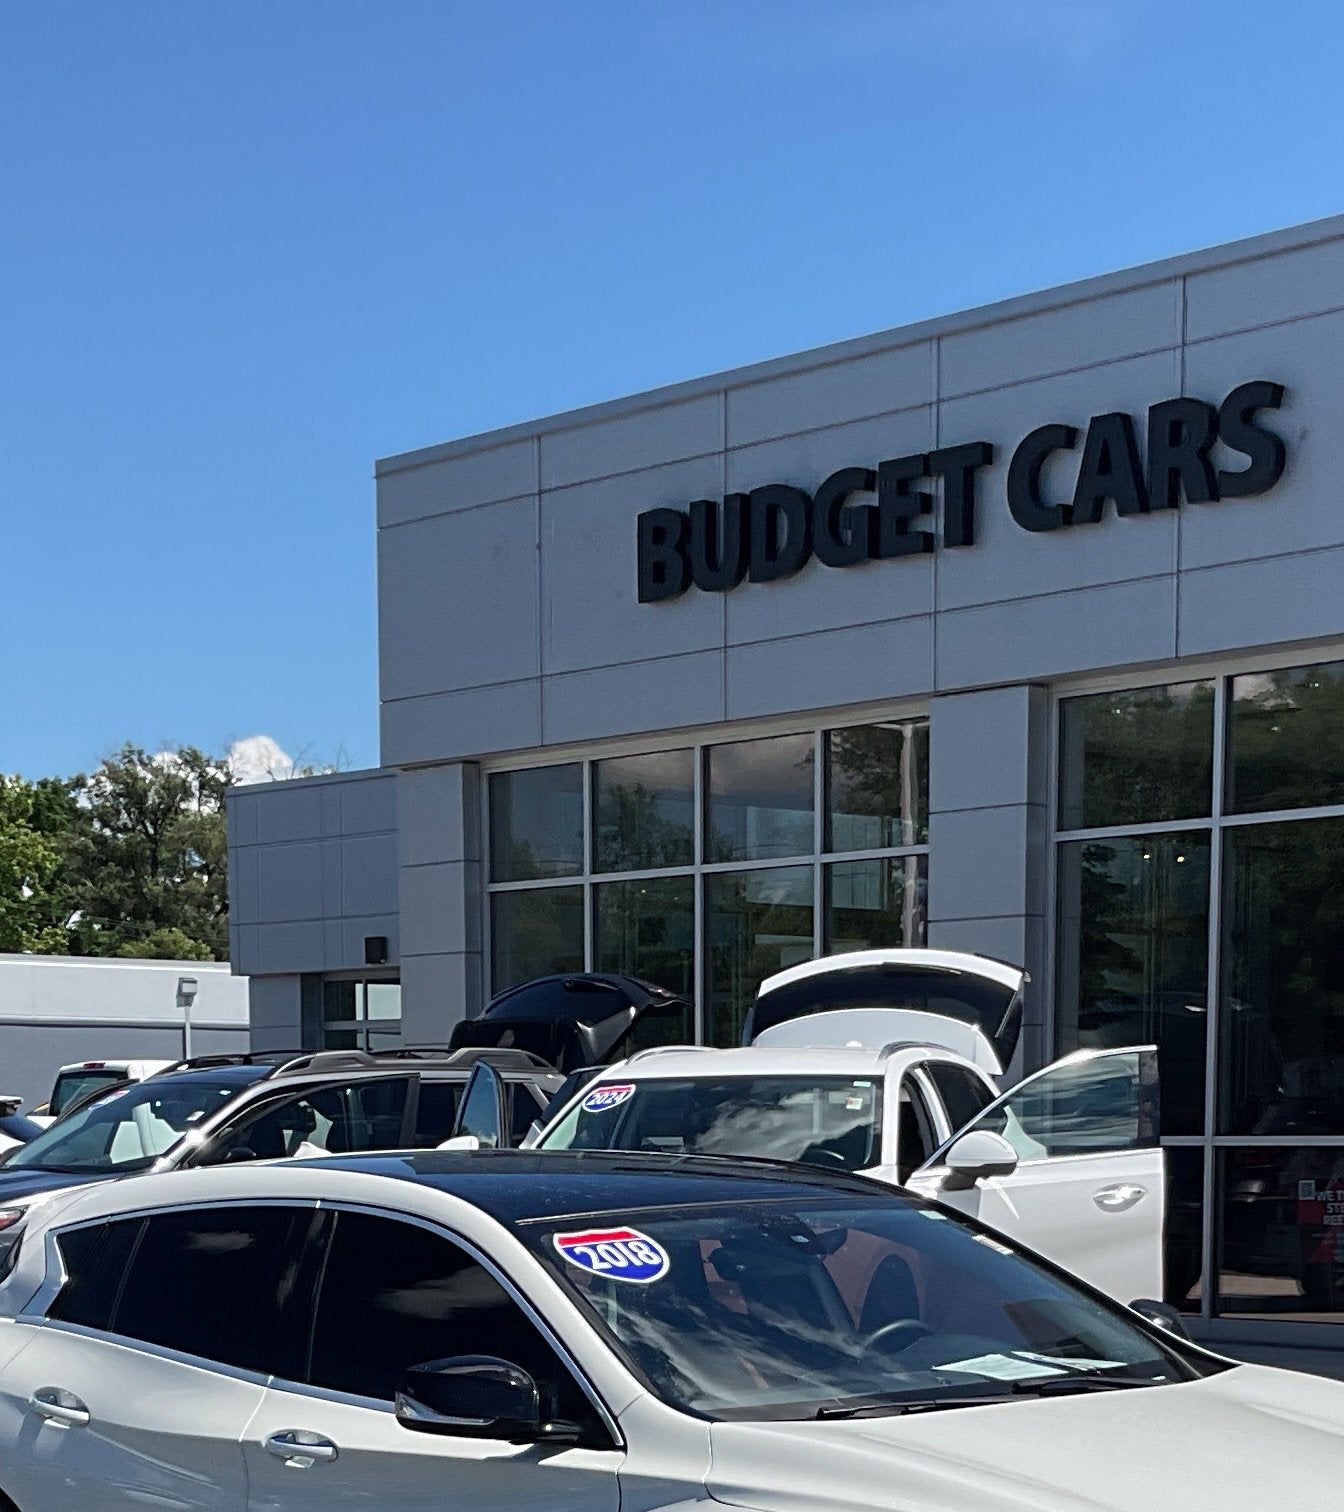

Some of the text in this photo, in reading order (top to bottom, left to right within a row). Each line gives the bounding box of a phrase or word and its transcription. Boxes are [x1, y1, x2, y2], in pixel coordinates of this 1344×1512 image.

[637, 380, 1287, 604] BUDGET CARS
[1316, 1190, 1335, 1201] WE
[573, 1240, 663, 1270] 2018
